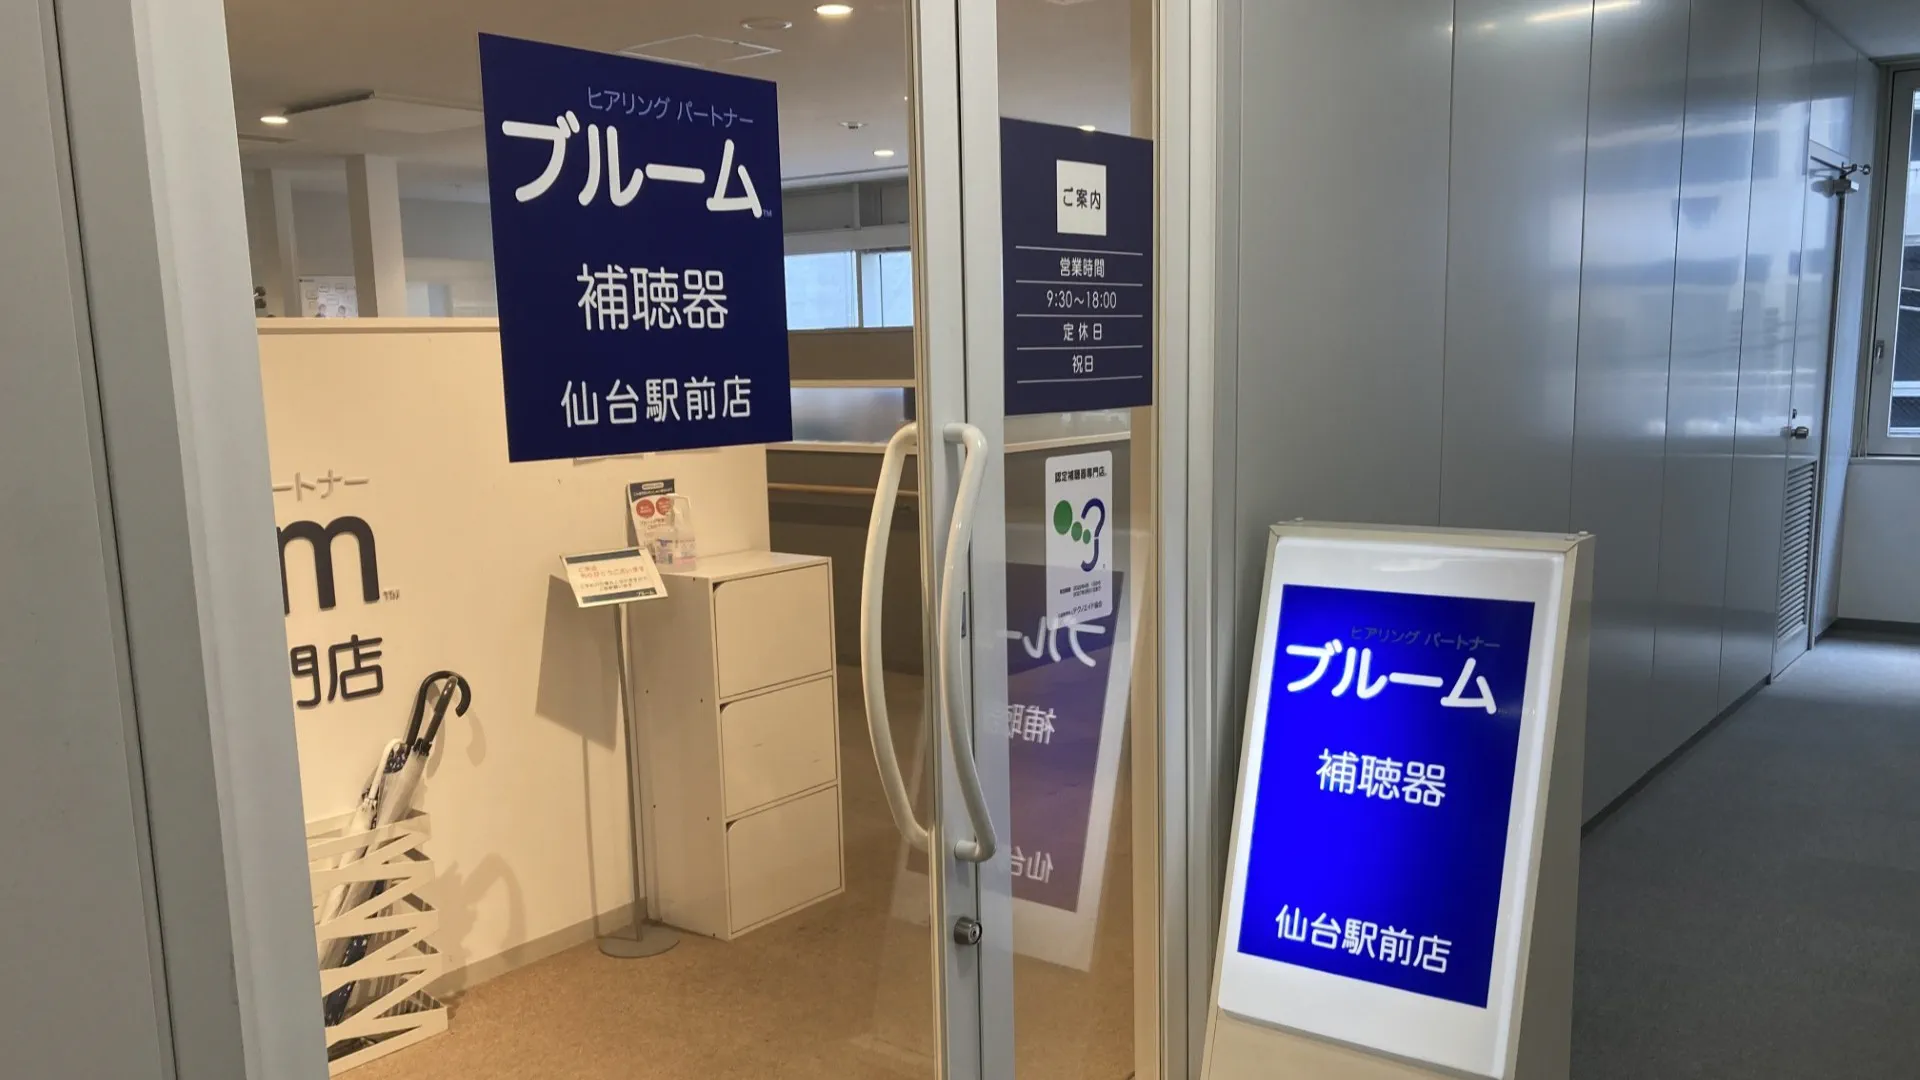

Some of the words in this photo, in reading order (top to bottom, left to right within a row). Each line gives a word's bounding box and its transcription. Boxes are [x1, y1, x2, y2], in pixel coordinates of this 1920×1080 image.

[587, 86, 671, 119] ヒアリング
[676, 100, 754, 129] パートナー
[501, 110, 762, 218] ブルーム
[1062, 187, 1102, 211] ご案内
[1059, 257, 1105, 278] 営業時間
[576, 262, 729, 331] 補聴器
[1063, 322, 1103, 342] 定休日
[1072, 354, 1094, 374] 祝日
[560, 374, 751, 428] 仙台駅前店
[1351, 626, 1421, 645] ヒアリング
[1424, 632, 1501, 651] パートナー
[1286, 638, 1497, 714] ブルーム
[1315, 747, 1446, 807] 補聴器
[1275, 903, 1452, 974] 仙台駅前店
